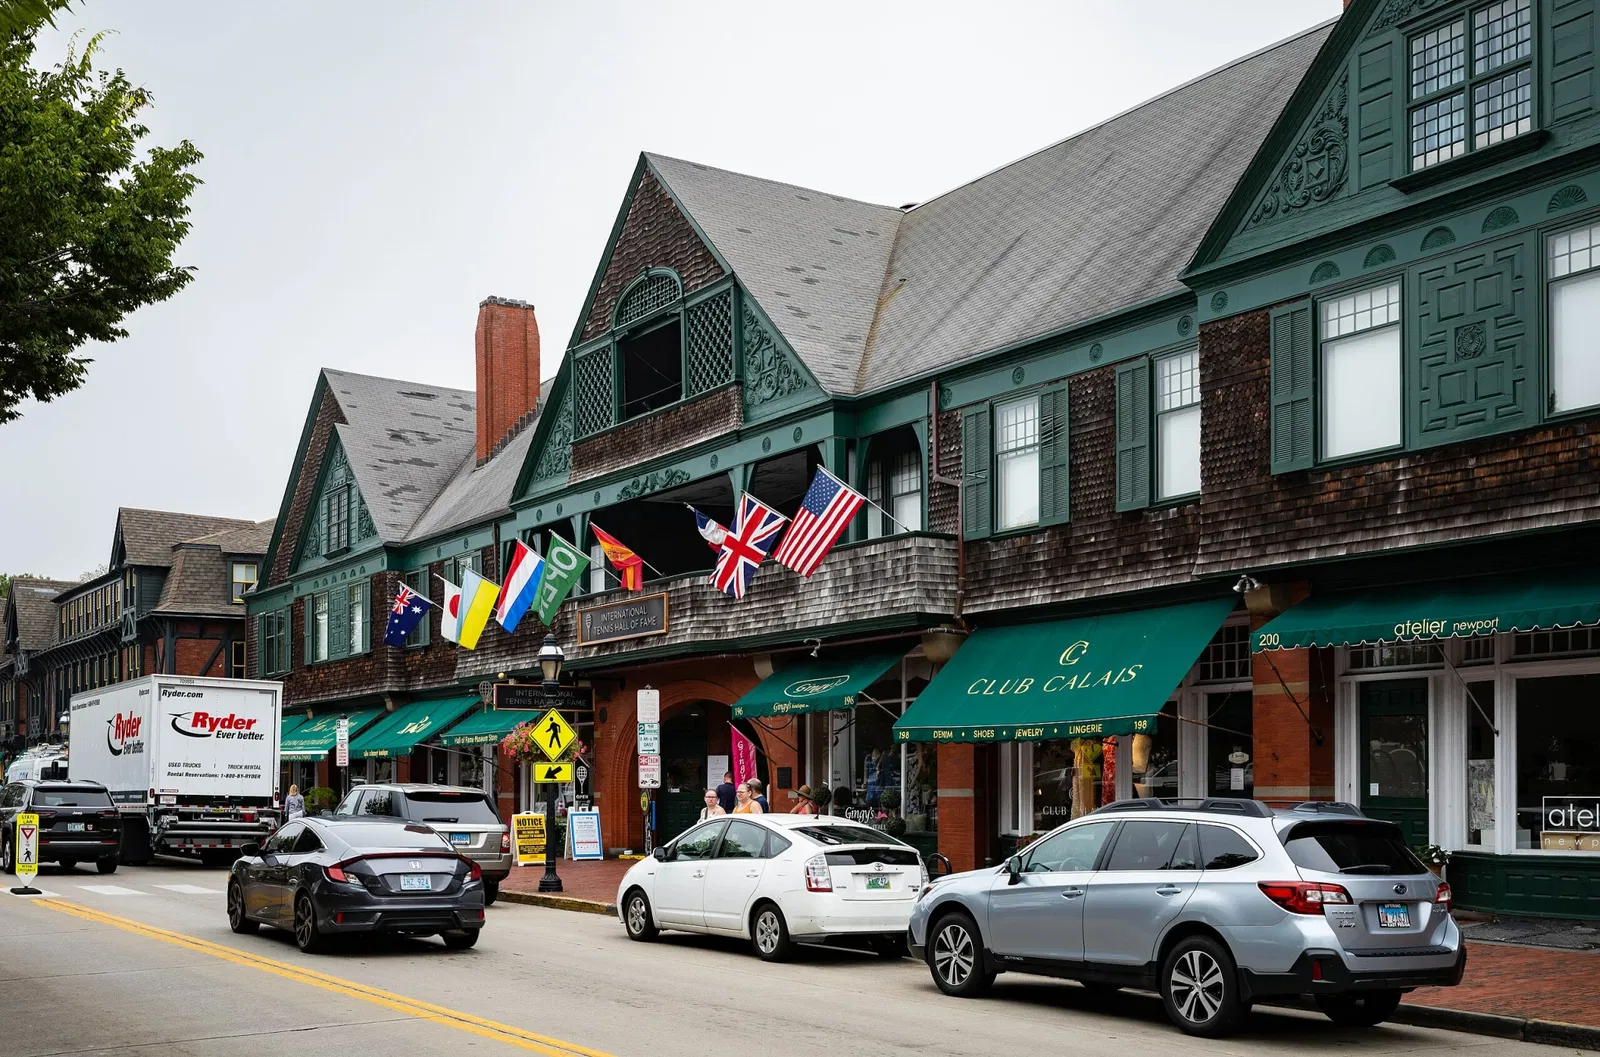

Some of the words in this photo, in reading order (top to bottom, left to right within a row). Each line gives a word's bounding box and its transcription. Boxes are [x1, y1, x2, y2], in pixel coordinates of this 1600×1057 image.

[601, 606, 647, 621] INTERNATIONAL
[594, 624, 614, 636] TENNIS
[614, 622, 630, 633] HALL
[630, 620, 640, 630] OF
[639, 617, 658, 629] FAME
[1259, 633, 1280, 647] 200
[1394, 618, 1447, 637] atelier
[1453, 617, 1499, 632] newport
[967, 678, 1035, 695] CLUB
[1043, 664, 1143, 693] CALAIS
[162, 689, 203, 698] Ryder.com
[844, 695, 854, 706] 196
[505, 698, 532, 706] TENNIS
[773, 701, 792, 713] Gingy's
[114, 710, 142, 746] Ryder
[191, 711, 257, 732] Ryder
[216, 730, 236, 739] Ever
[237, 731, 264, 741] better.
[899, 731, 910, 740] 198
[933, 730, 953, 739] DENIM
[973, 729, 995, 738] SHOES
[1015, 727, 1044, 740] JEWELRY
[1069, 723, 1103, 735] LINGERIE
[1133, 719, 1148, 731] 198
[845, 806, 875, 824] Gingy's
[1042, 805, 1067, 815] CLUB
[517, 818, 543, 826] NOTICE
